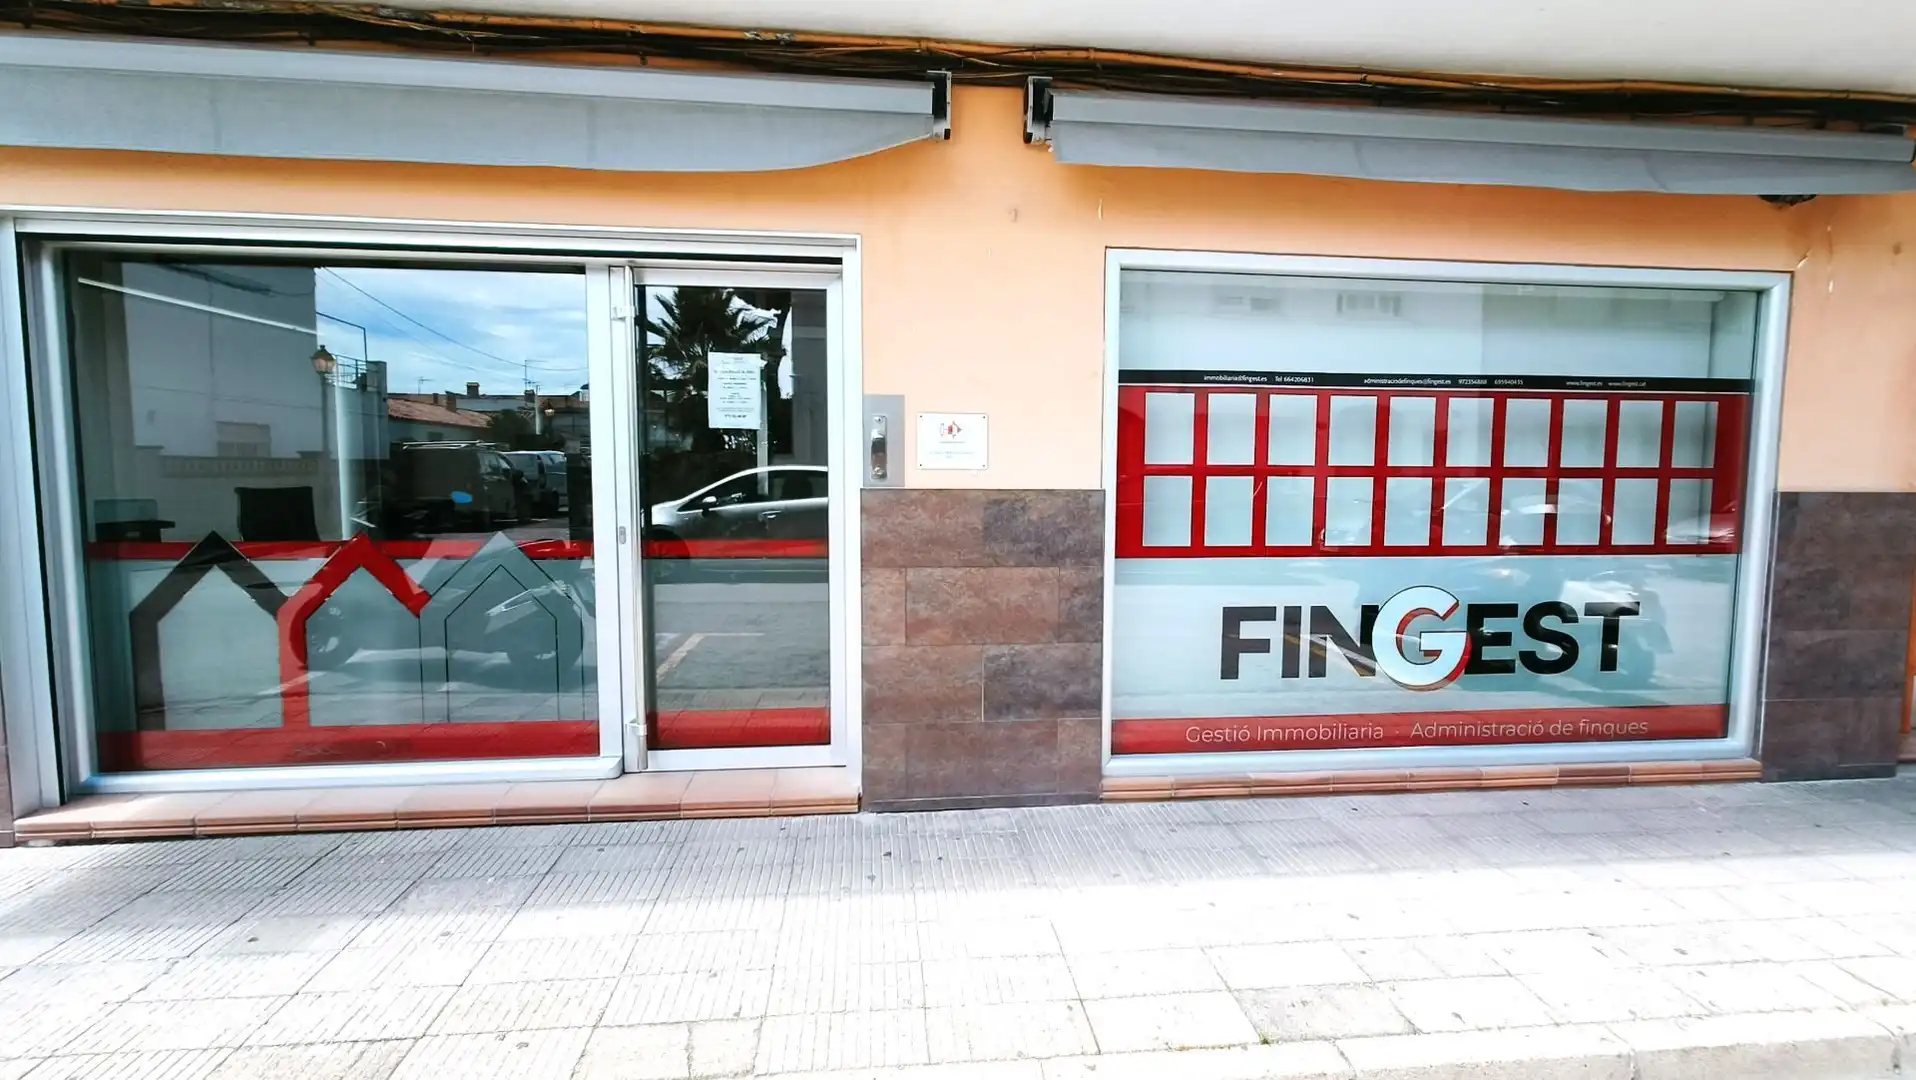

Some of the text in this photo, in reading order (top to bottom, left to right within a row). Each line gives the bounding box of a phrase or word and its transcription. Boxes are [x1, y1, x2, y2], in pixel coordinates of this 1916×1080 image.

[1220, 585, 1640, 691] FINGEST
[1185, 718, 1649, 743] Gestió Immobiliaria Administració de finques
